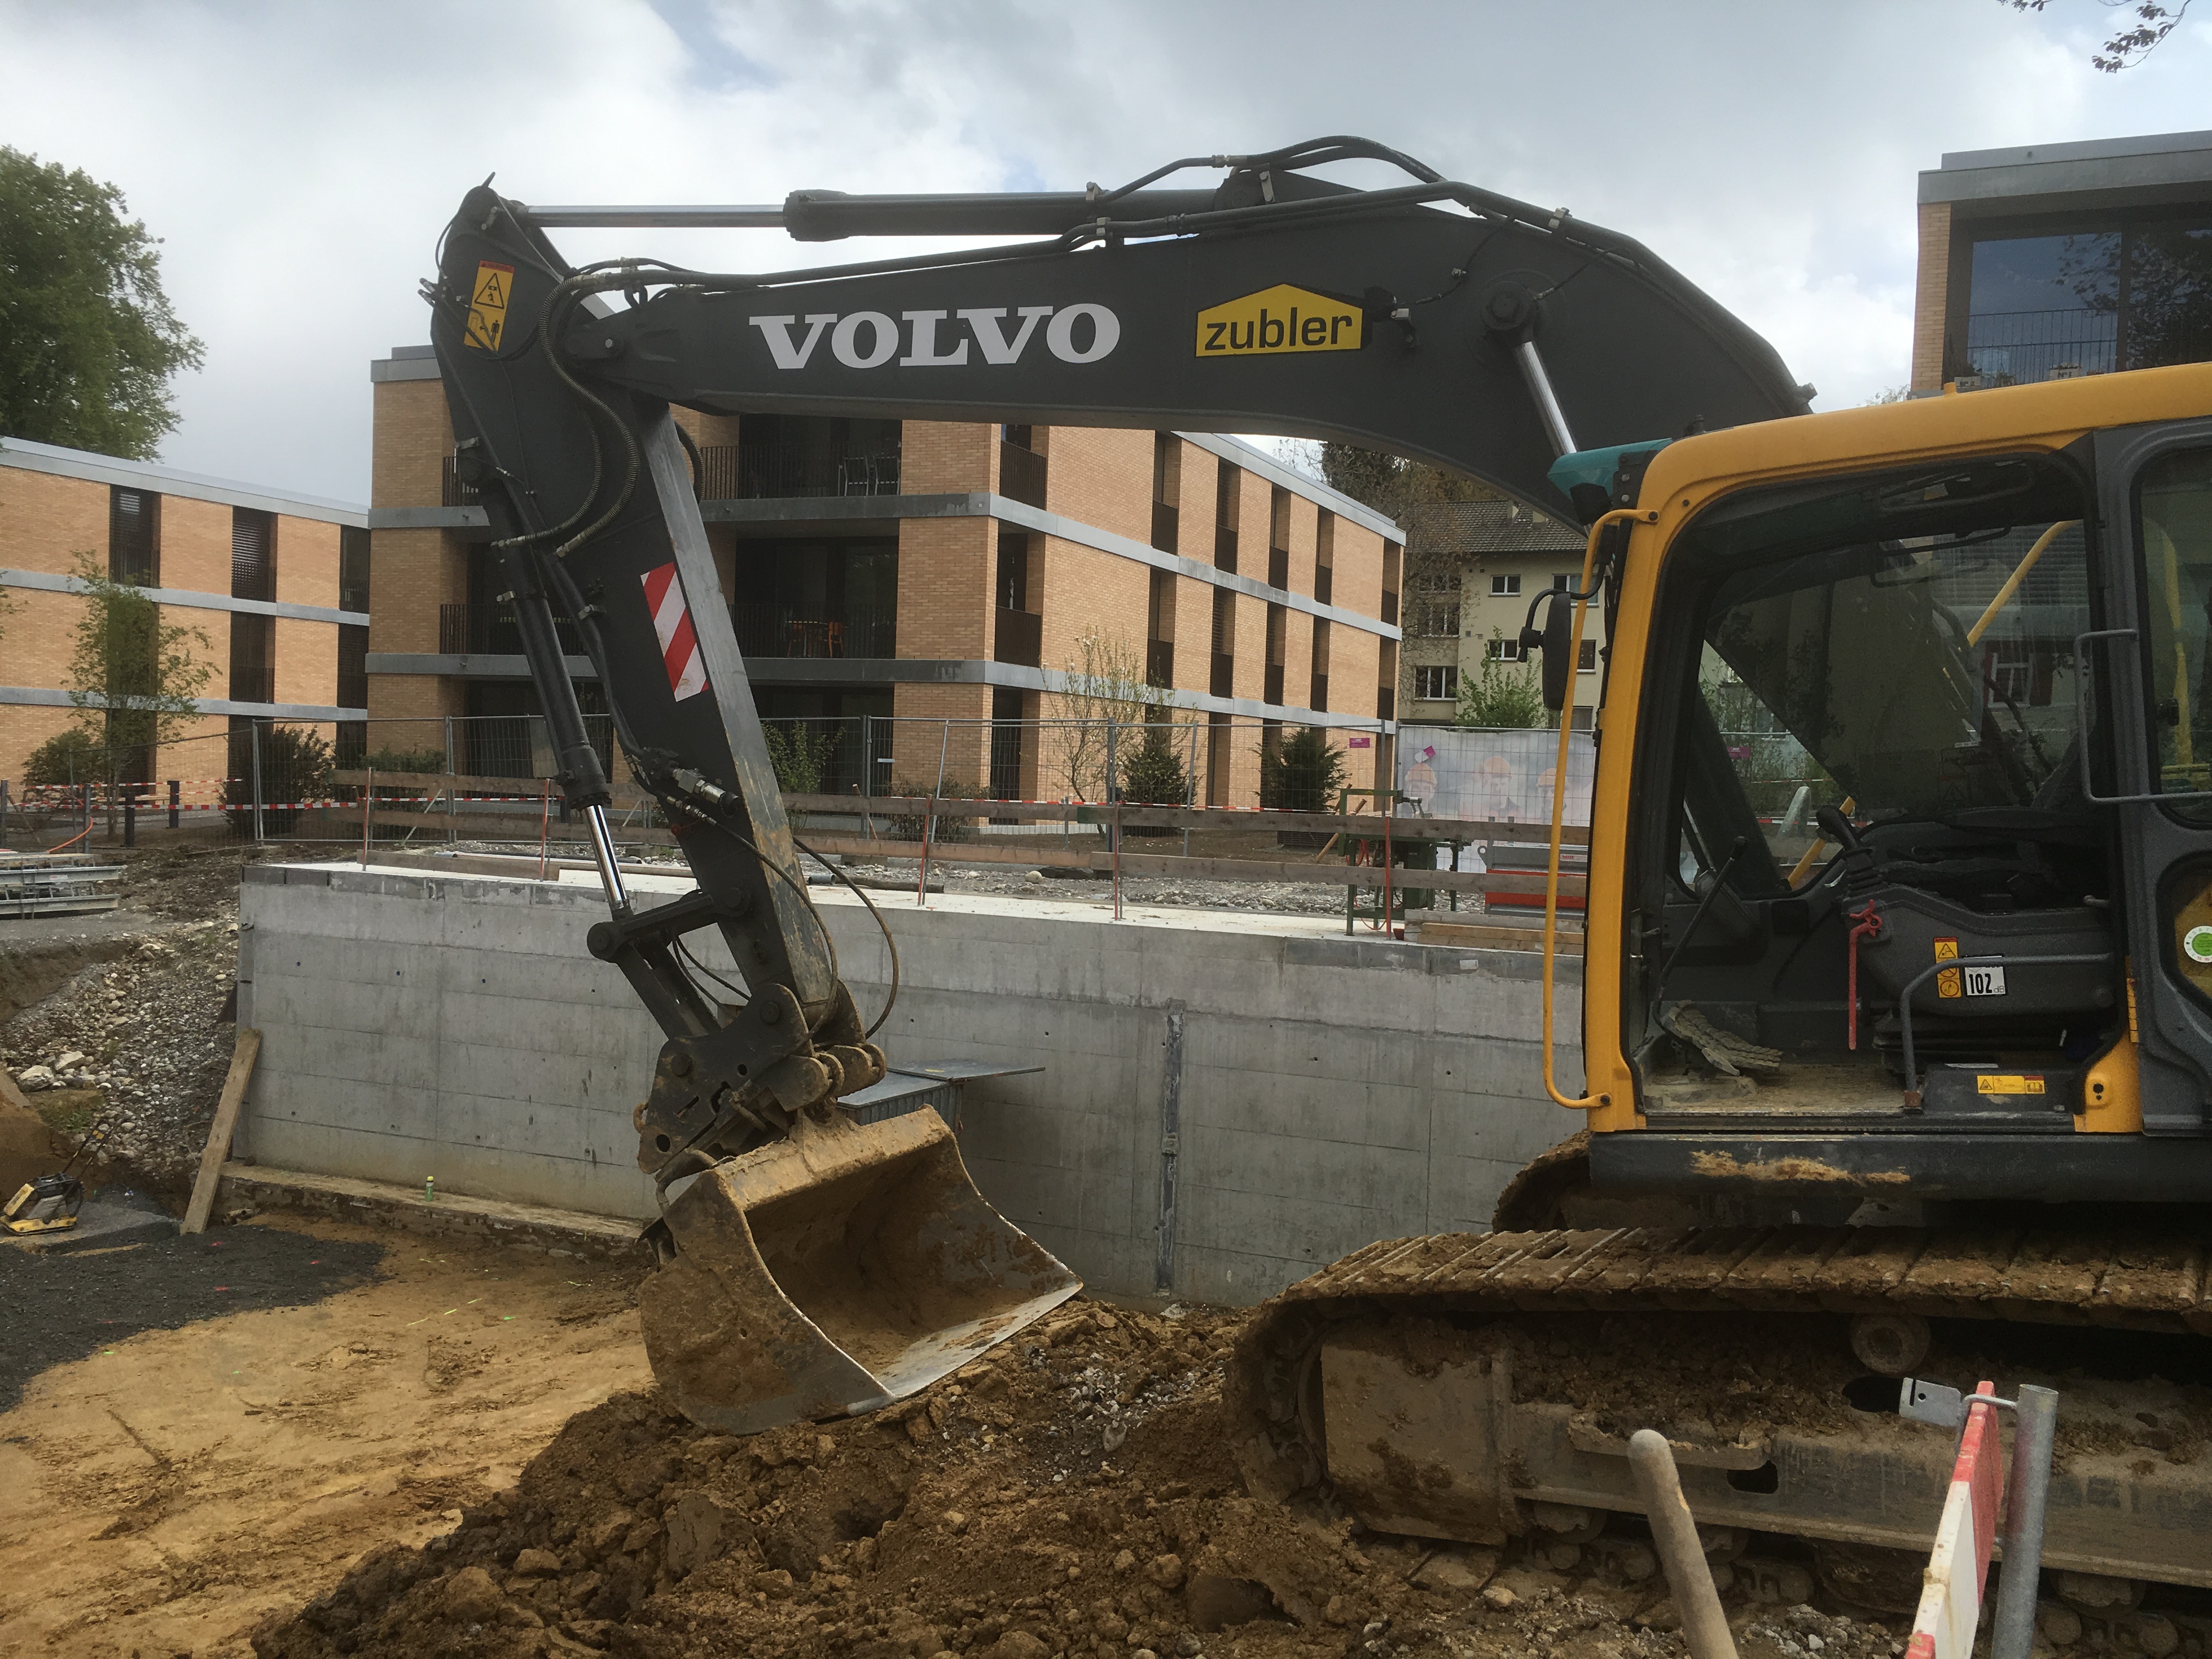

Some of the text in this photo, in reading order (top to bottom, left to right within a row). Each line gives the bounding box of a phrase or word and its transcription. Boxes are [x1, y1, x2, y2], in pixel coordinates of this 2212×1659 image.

[749, 303, 1121, 369] VOLVO
[1205, 307, 1352, 351] zubler
[1969, 973, 1993, 994] 102
